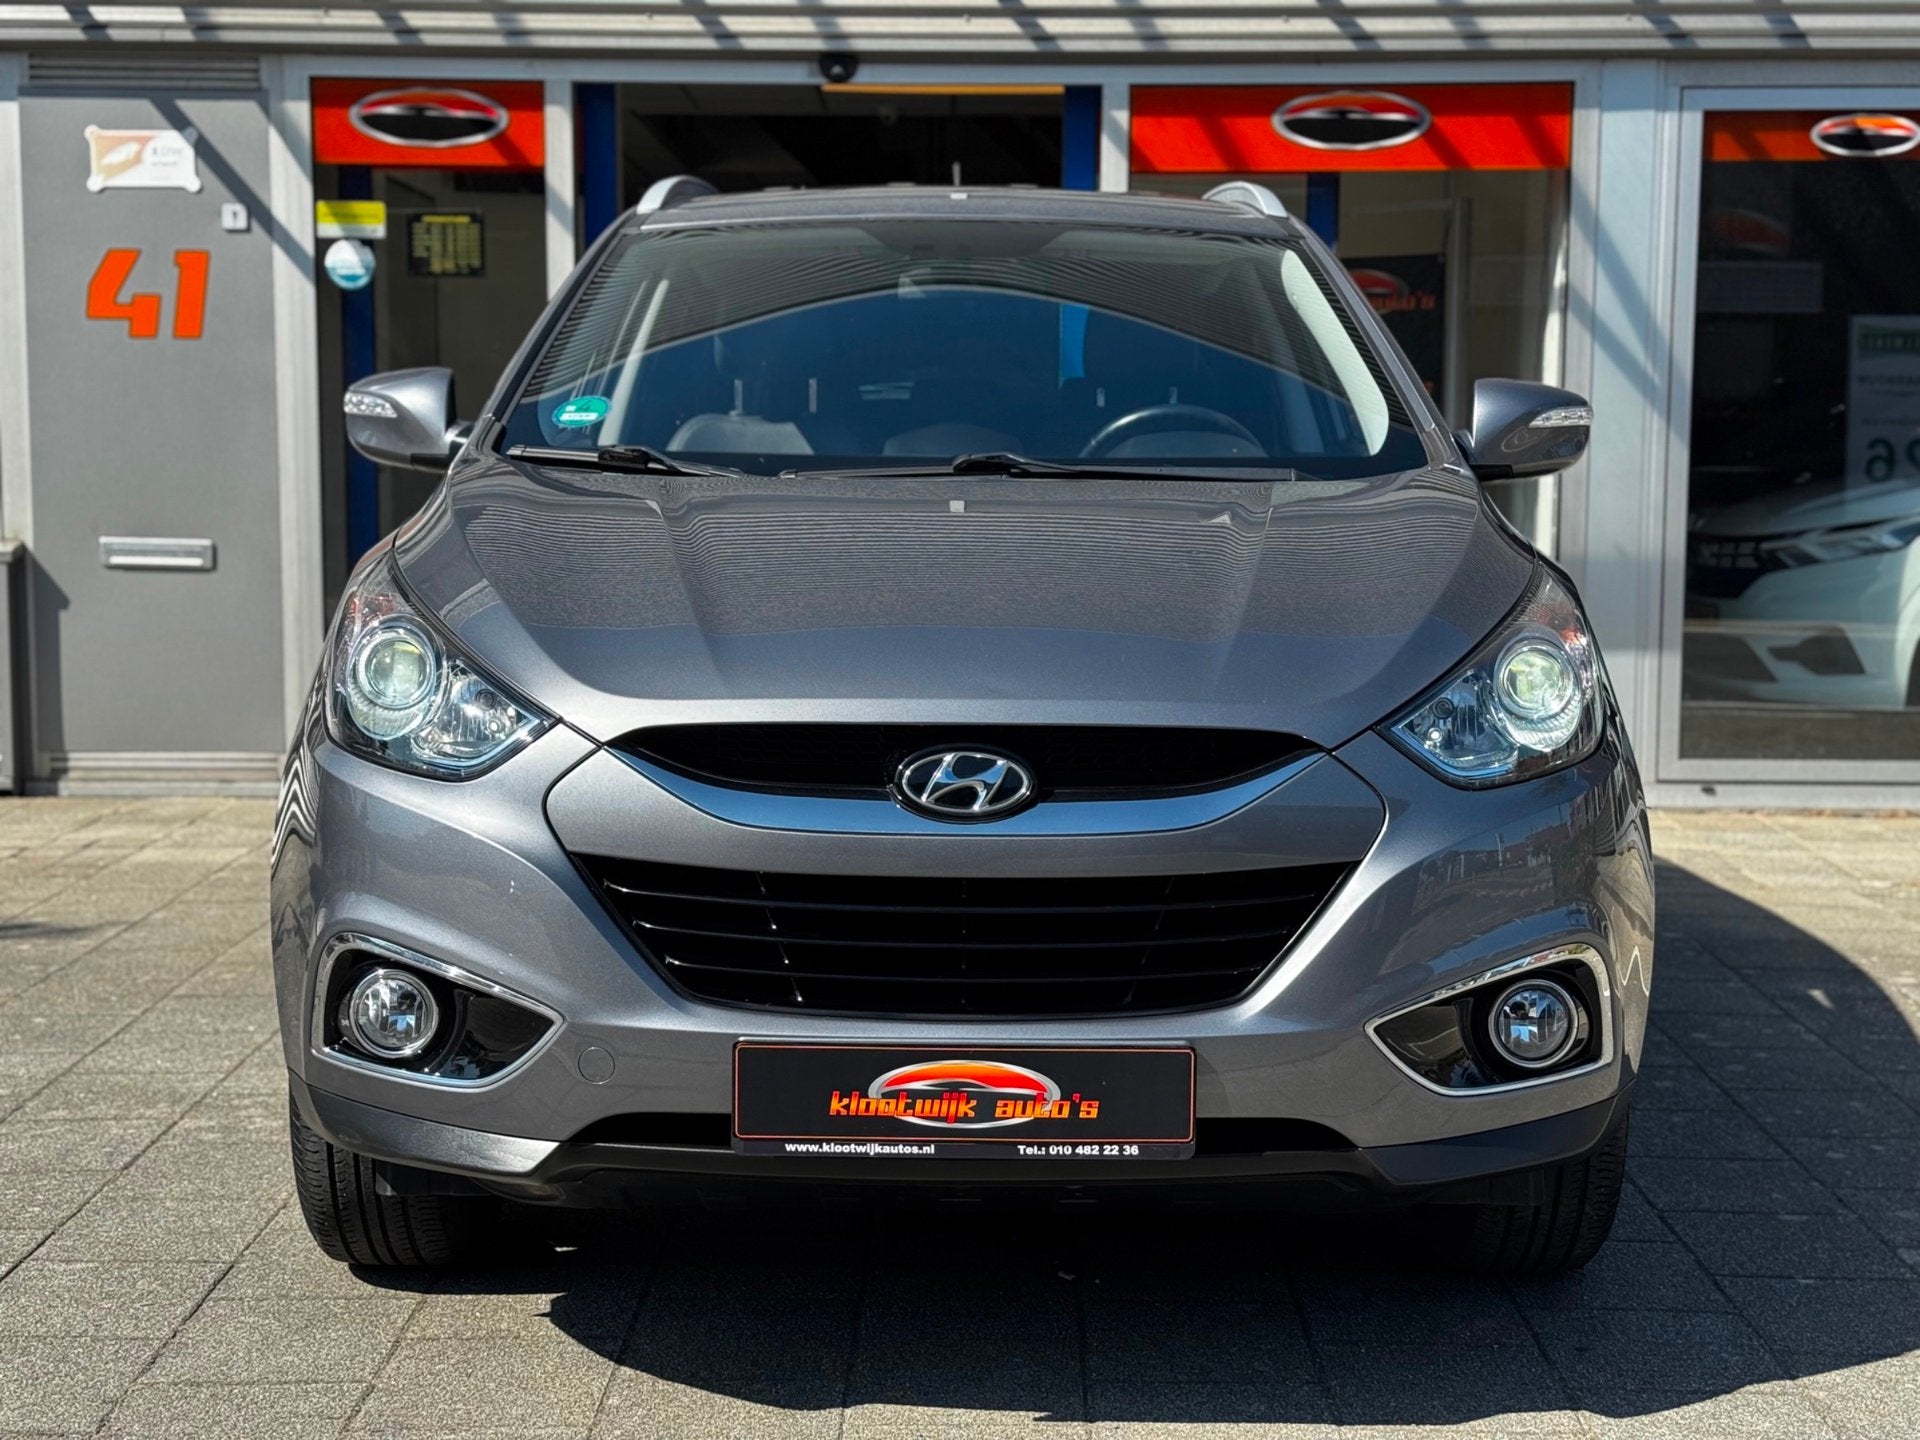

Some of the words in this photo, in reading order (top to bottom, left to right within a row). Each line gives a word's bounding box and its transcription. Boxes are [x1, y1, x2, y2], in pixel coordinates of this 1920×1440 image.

[86, 248, 211, 340] 41
[829, 1091, 976, 1124] klootwijk
[994, 1093, 1100, 1119] auto's
[784, 1142, 935, 1156] www.klootwijkautos.nl
[1017, 1145, 1046, 1156] Tel.:
[1048, 1145, 1073, 1156] 010
[1075, 1145, 1100, 1156] 482
[1102, 1145, 1120, 1156] 22
[1122, 1145, 1140, 1156] 36
